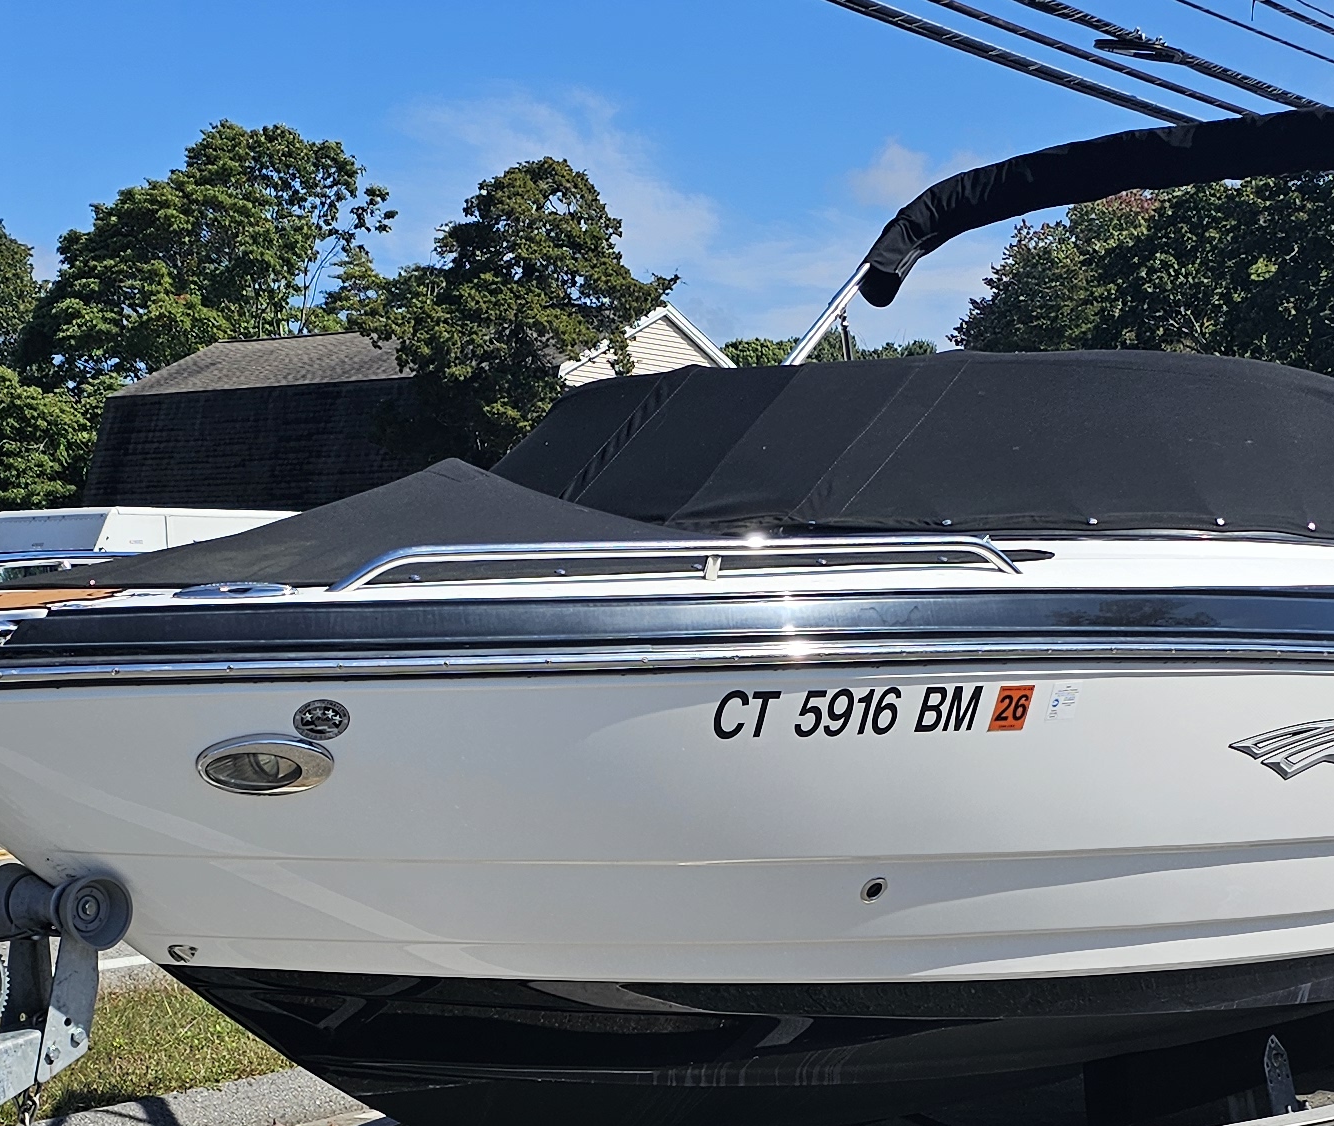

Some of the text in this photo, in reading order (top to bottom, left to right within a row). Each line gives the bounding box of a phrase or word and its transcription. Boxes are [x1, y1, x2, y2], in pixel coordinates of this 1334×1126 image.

[713, 685, 984, 740] CT 5916 BM
[993, 693, 1029, 722] 26
